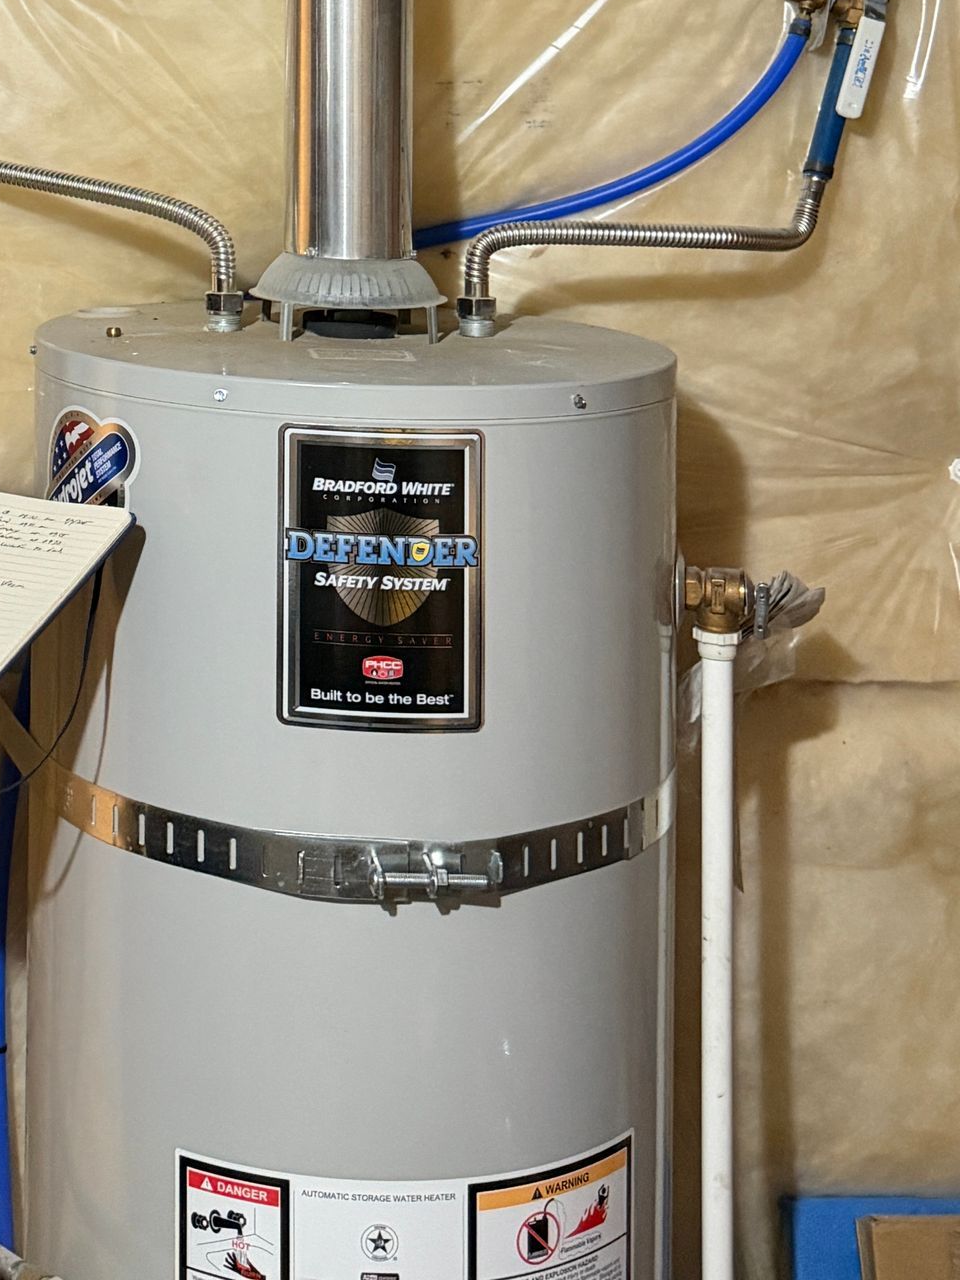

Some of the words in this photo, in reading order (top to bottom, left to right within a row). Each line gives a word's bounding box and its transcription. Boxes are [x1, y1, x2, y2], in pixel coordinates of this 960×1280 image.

[93, 441, 122, 470] PERFORMANCE
[52, 459, 94, 503] drojet
[312, 477, 397, 495] BRADFORD
[401, 481, 453, 496] WHITE
[323, 494, 440, 504] CORPORATION
[286, 529, 478, 567] DEFENDER
[314, 571, 379, 590] SAFETY
[380, 575, 448, 591] SYSTEM
[314, 631, 384, 644] ENERGY
[397, 637, 453, 646] SAVER
[365, 660, 402, 670] PHCC
[310, 688, 343, 702] Built
[346, 691, 362, 703] to
[365, 692, 385, 704] be
[388, 693, 412, 705] the
[416, 693, 450, 705] Best
[217, 1181, 268, 1202] DANGER
[545, 1172, 590, 1195] WARNING
[301, 1189, 349, 1201] AUTOMATIC
[351, 1194, 391, 1203] STORAGE
[393, 1194, 422, 1203] WATER
[423, 1193, 456, 1202] HEATER
[231, 1239, 250, 1251] HOT
